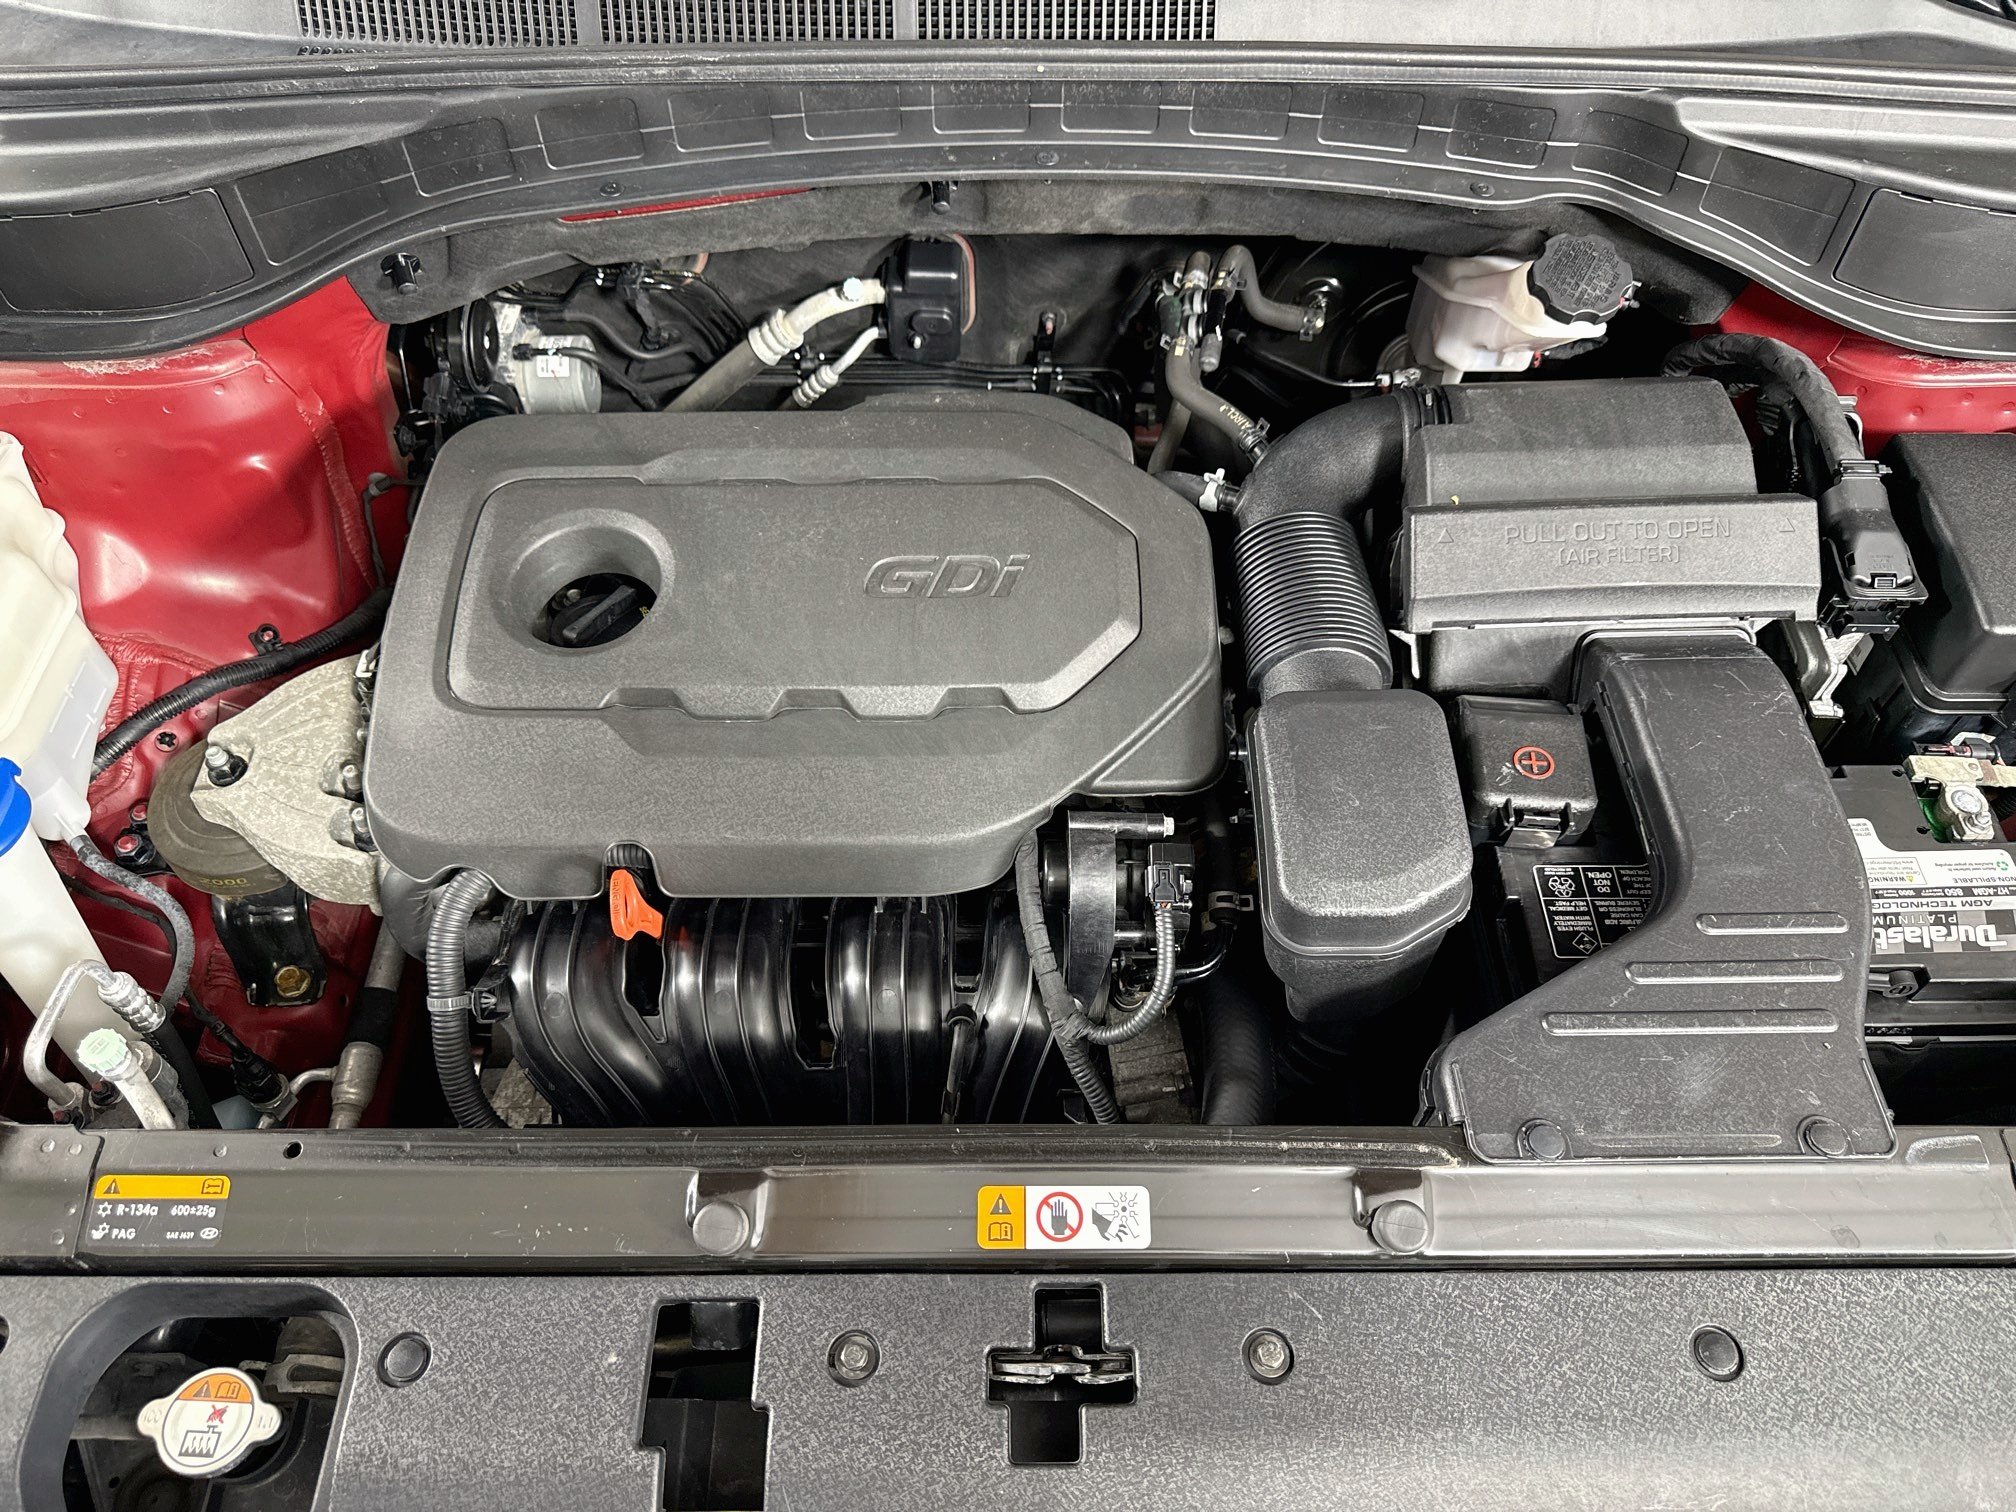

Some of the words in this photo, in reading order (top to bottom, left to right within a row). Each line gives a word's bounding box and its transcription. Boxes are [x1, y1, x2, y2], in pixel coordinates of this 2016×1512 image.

[1505, 524, 1566, 544] PULL
[1573, 520, 1621, 542] OUT
[1628, 520, 1659, 540] TO
[1667, 518, 1731, 540] OPEN
[864, 554, 1030, 598] GDi
[1585, 871, 1612, 879] OPEN.
[1944, 888, 1964, 896] 850
[1971, 886, 2010, 896] H7-AGM
[1871, 900, 1958, 910] TECHNOLOG
[1961, 899, 1993, 907] AGM
[1872, 913, 1958, 926] PLATINUM
[1873, 924, 2008, 950] Duralast
[116, 1203, 159, 1216] R-134a
[170, 1205, 217, 1218] 600±25g
[111, 1228, 136, 1240] PAG
[165, 1232, 179, 1240] SAE
